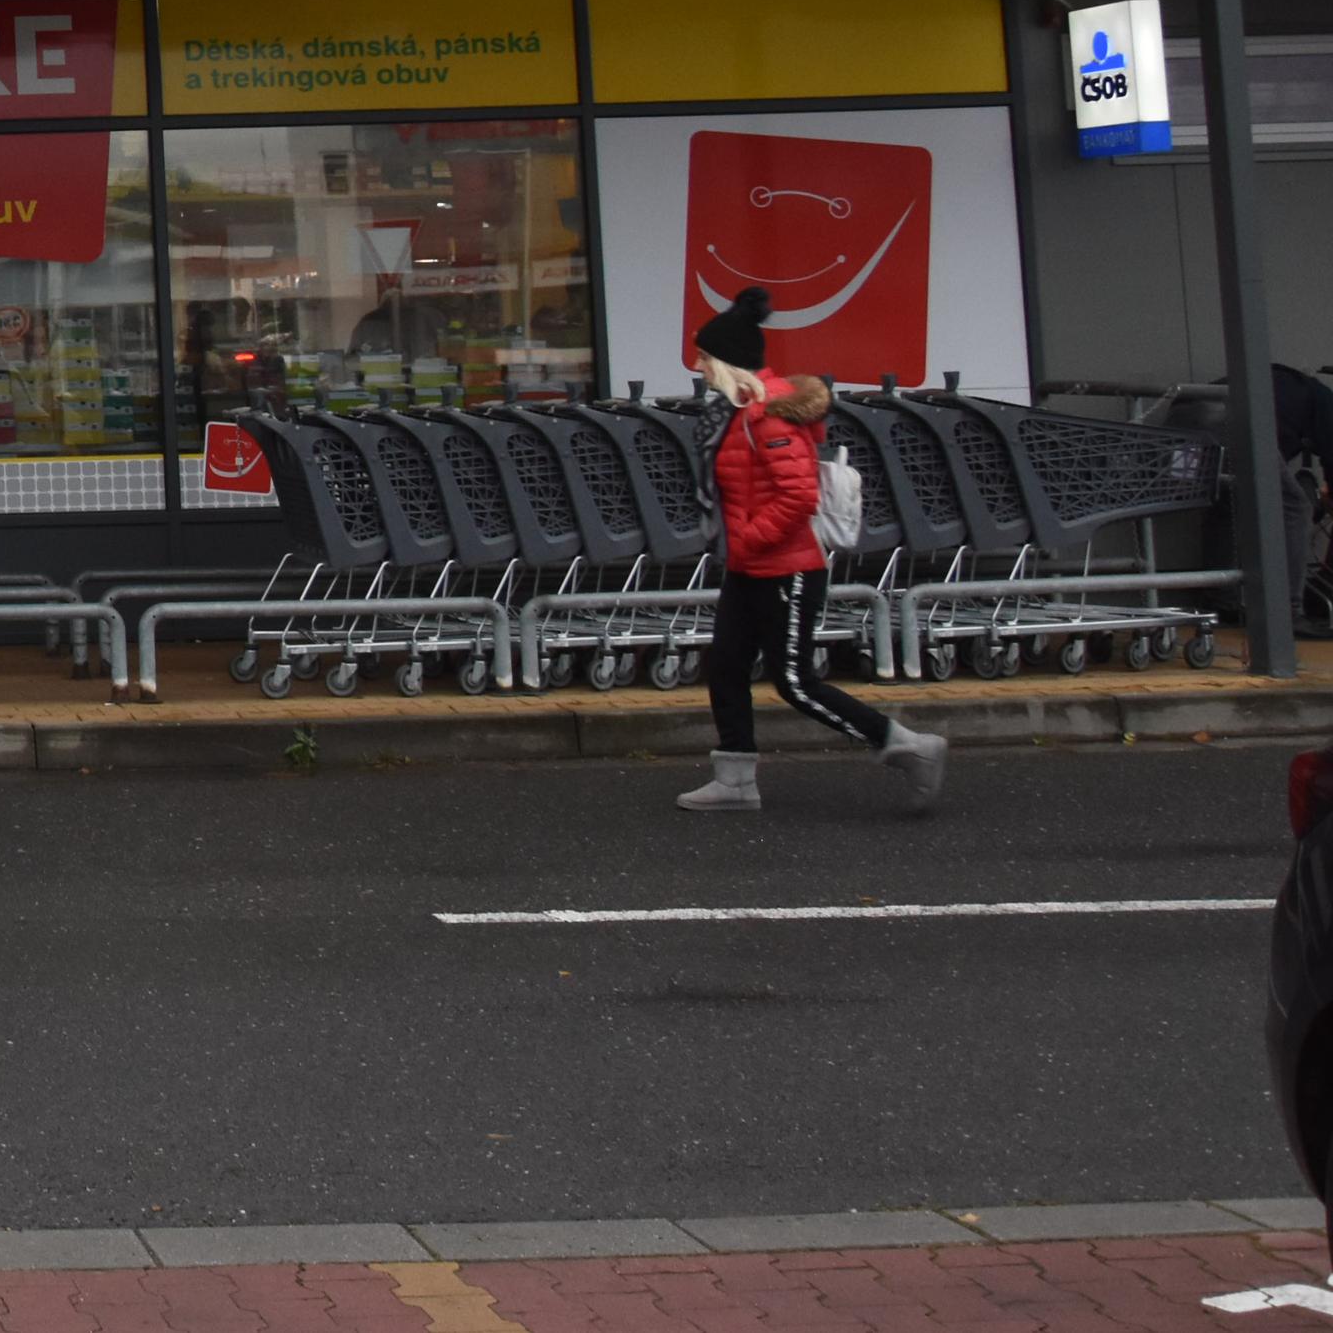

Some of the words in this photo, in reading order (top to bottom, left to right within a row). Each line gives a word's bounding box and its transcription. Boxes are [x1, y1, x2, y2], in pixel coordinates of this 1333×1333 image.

[184, 38, 294, 62] Dětská,
[301, 34, 426, 60] dámská,
[435, 30, 542, 59] pánská
[184, 71, 202, 89] a
[211, 63, 368, 93] trekingová
[376, 62, 449, 85] obuv
[1080, 73, 1128, 103] ČSOB
